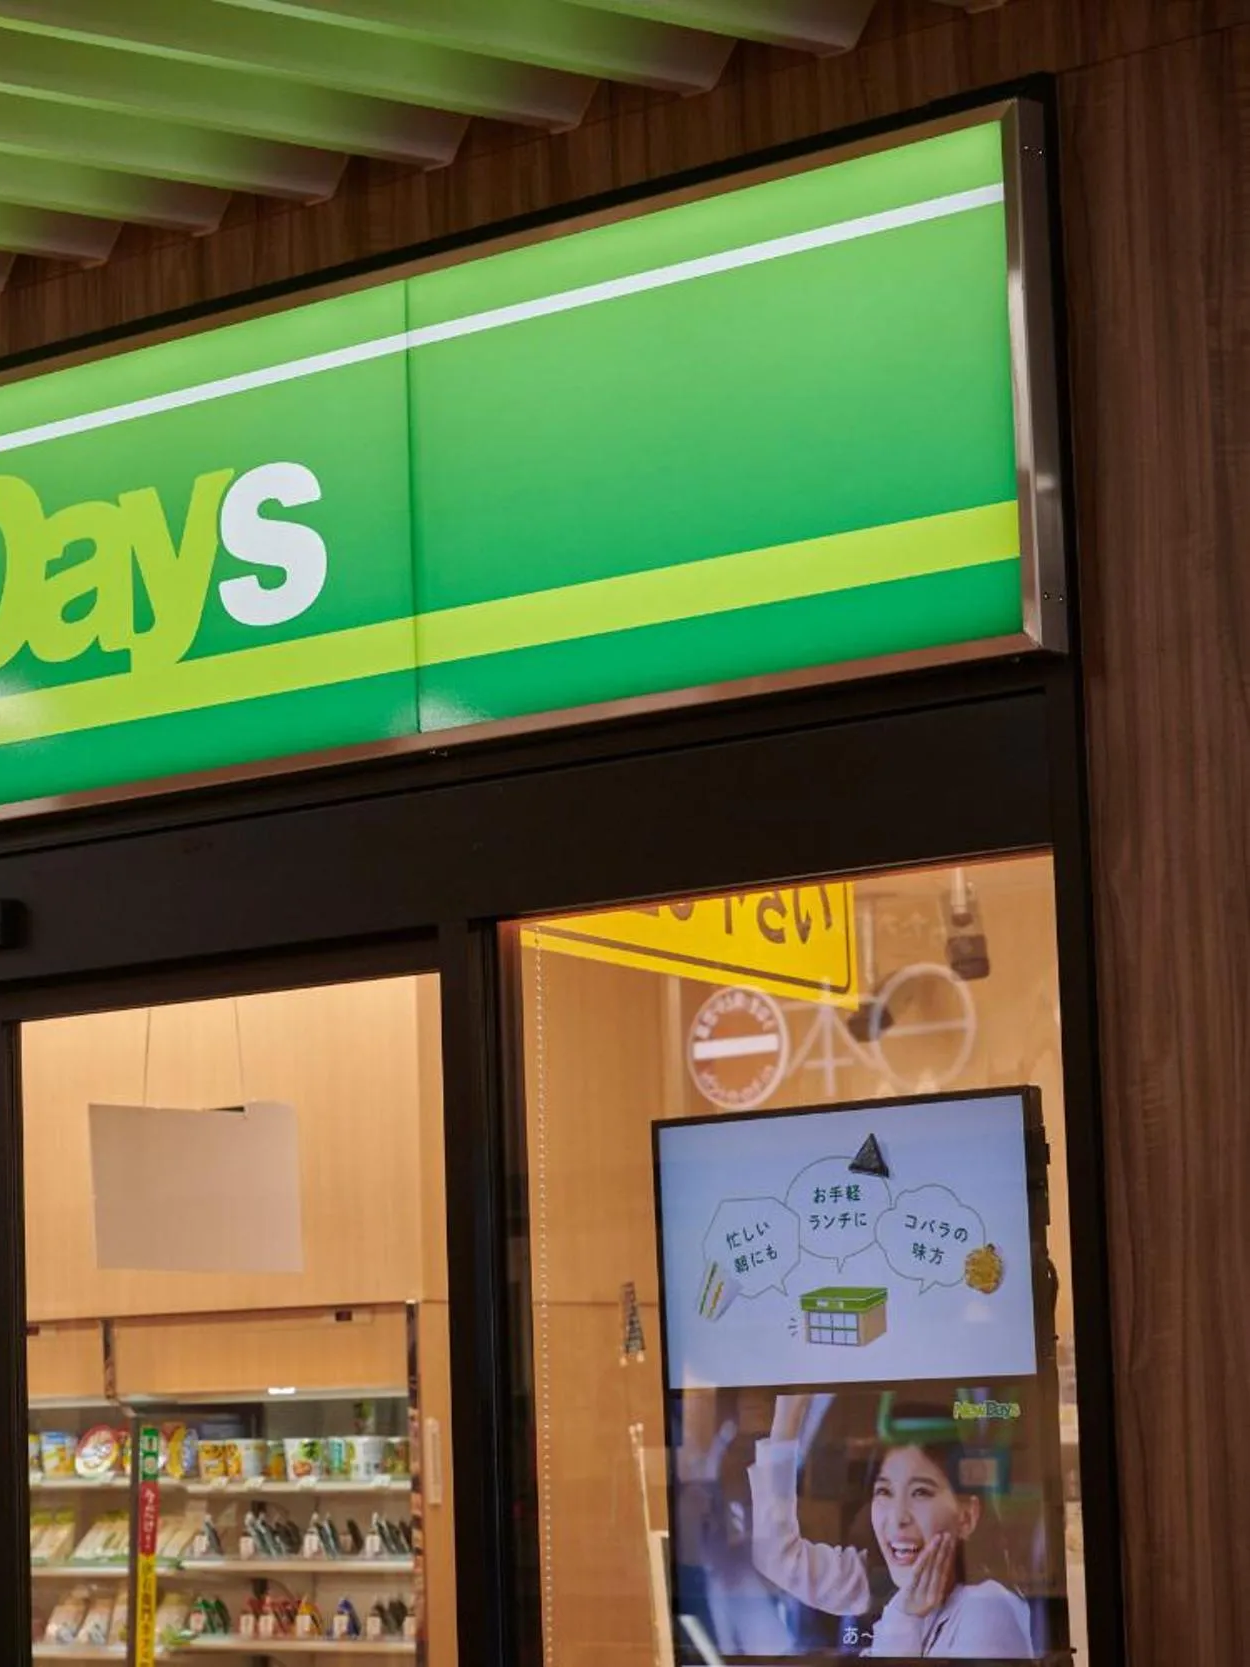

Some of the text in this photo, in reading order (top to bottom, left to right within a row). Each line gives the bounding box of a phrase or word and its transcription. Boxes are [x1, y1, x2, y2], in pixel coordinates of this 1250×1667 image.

[812, 1184, 861, 1204] お手軽
[808, 1211, 868, 1230] ランチに
[904, 1214, 968, 1243] コバラの
[725, 1221, 771, 1250] 忙しい
[733, 1245, 779, 1273] 朝にも
[911, 1242, 946, 1266] 味方
